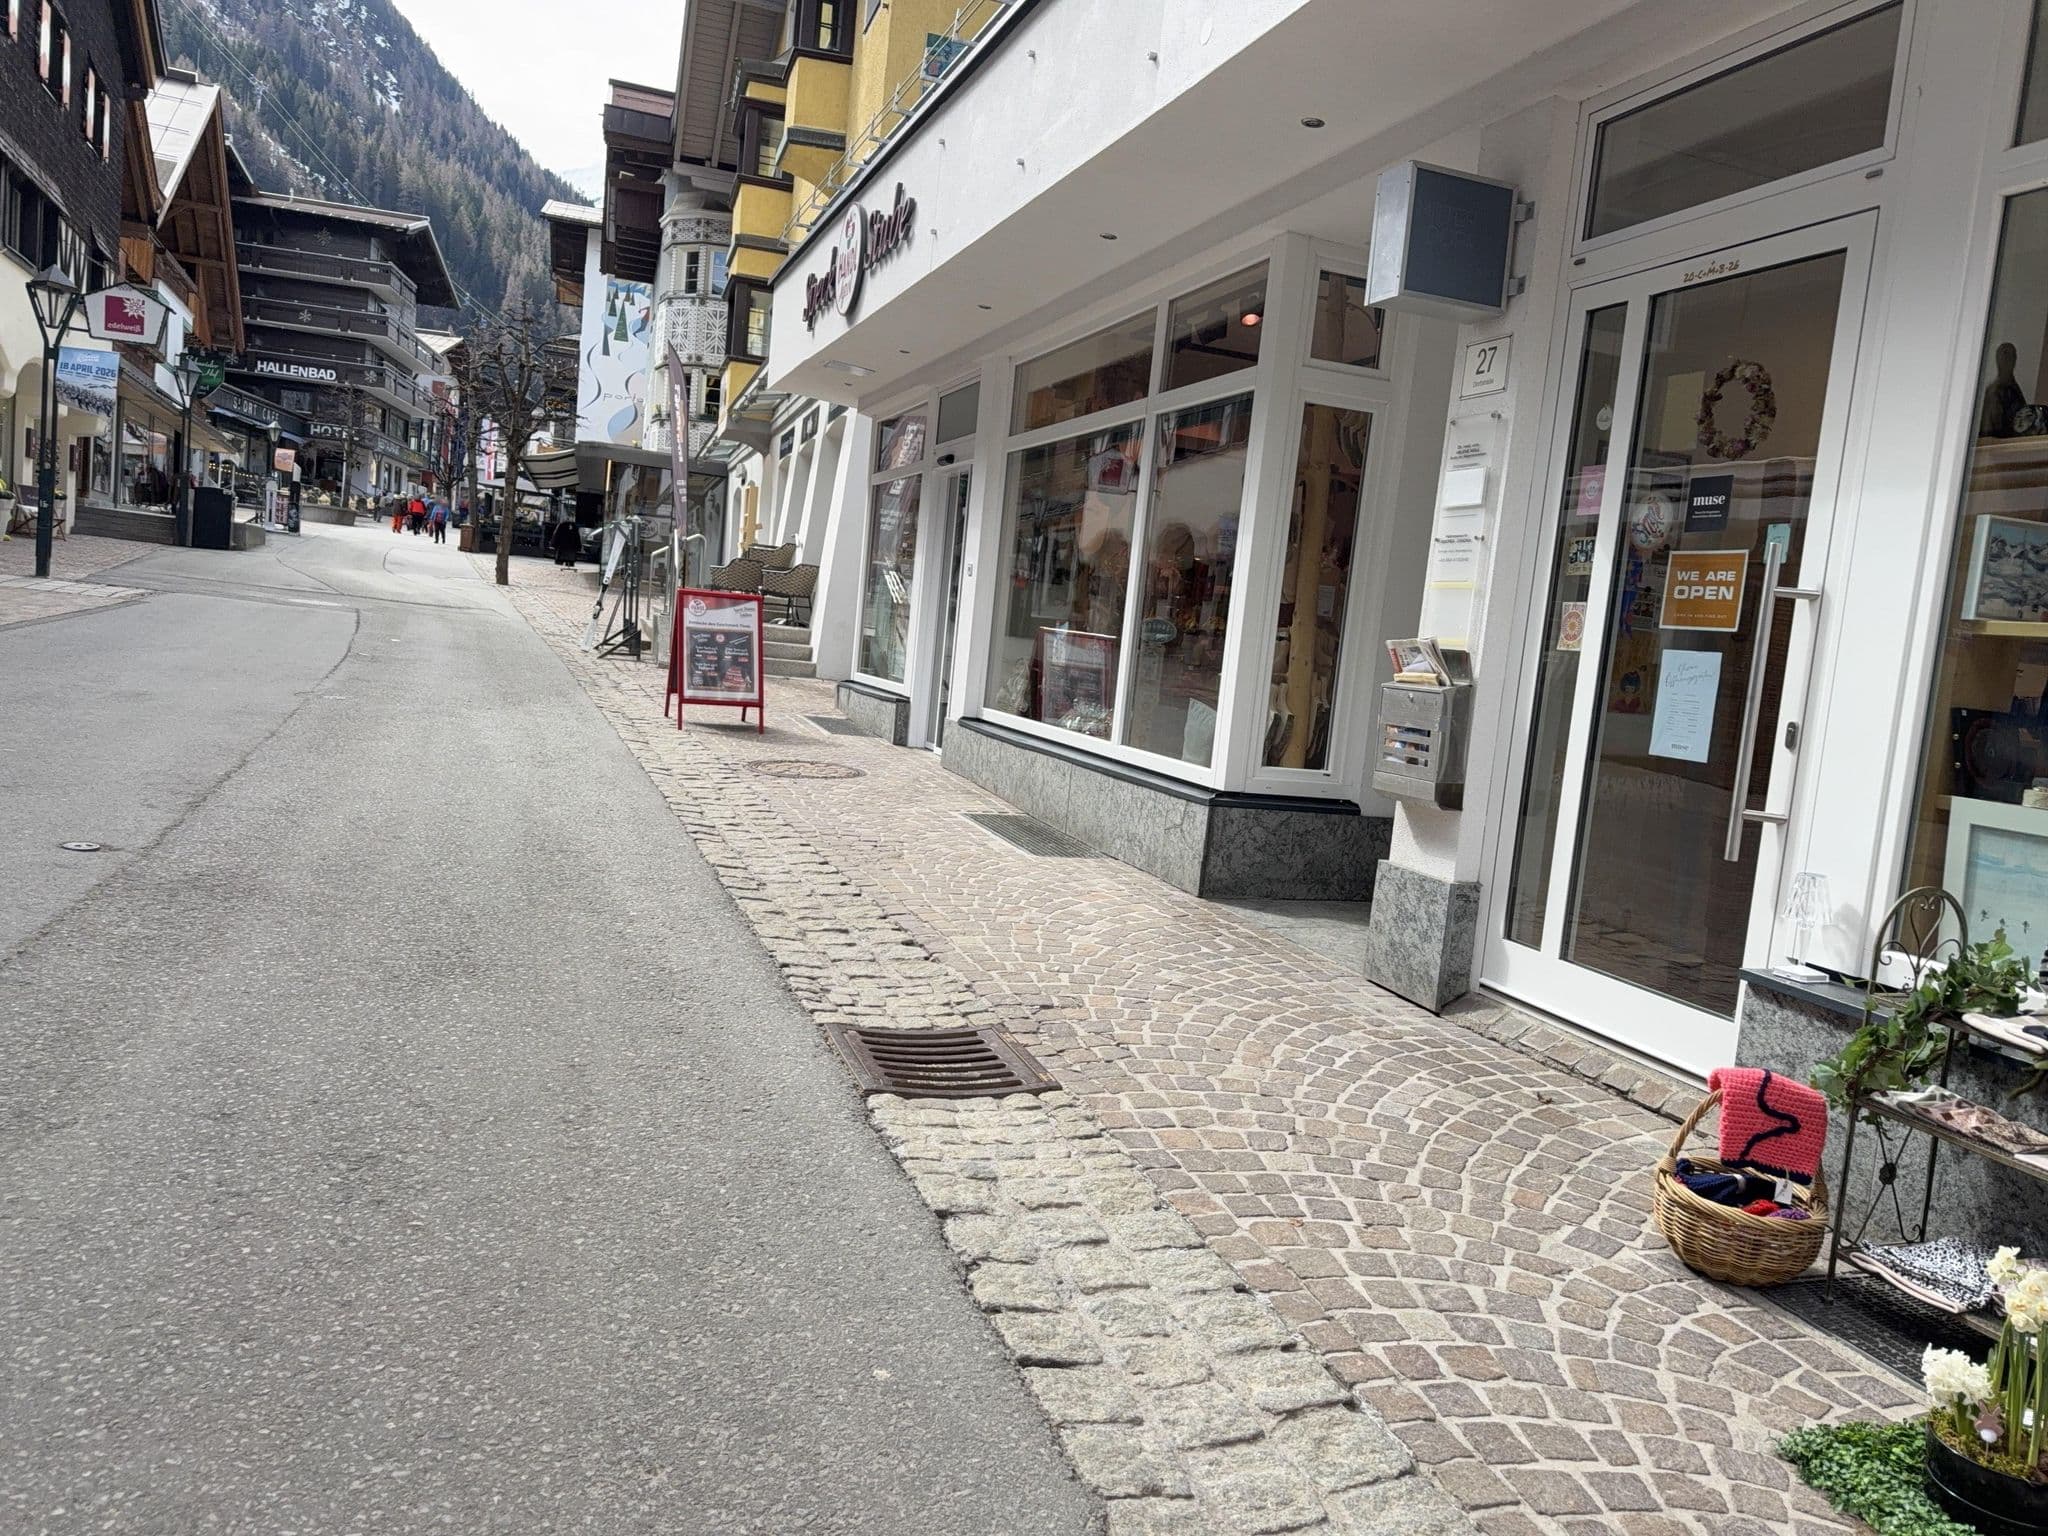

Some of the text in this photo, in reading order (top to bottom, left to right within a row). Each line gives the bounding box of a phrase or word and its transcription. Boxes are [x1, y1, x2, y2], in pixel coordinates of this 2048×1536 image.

[863, 182, 917, 269] Stube
[1475, 346, 1498, 375] 27
[59, 362, 69, 370] 18
[71, 363, 93, 375] APRIL
[95, 366, 117, 378] 2026
[257, 360, 337, 380] HALLENBAD
[1692, 494, 1726, 507] muse
[1677, 570, 1737, 581] WE ARE
[1673, 585, 1734, 601] OPEN
